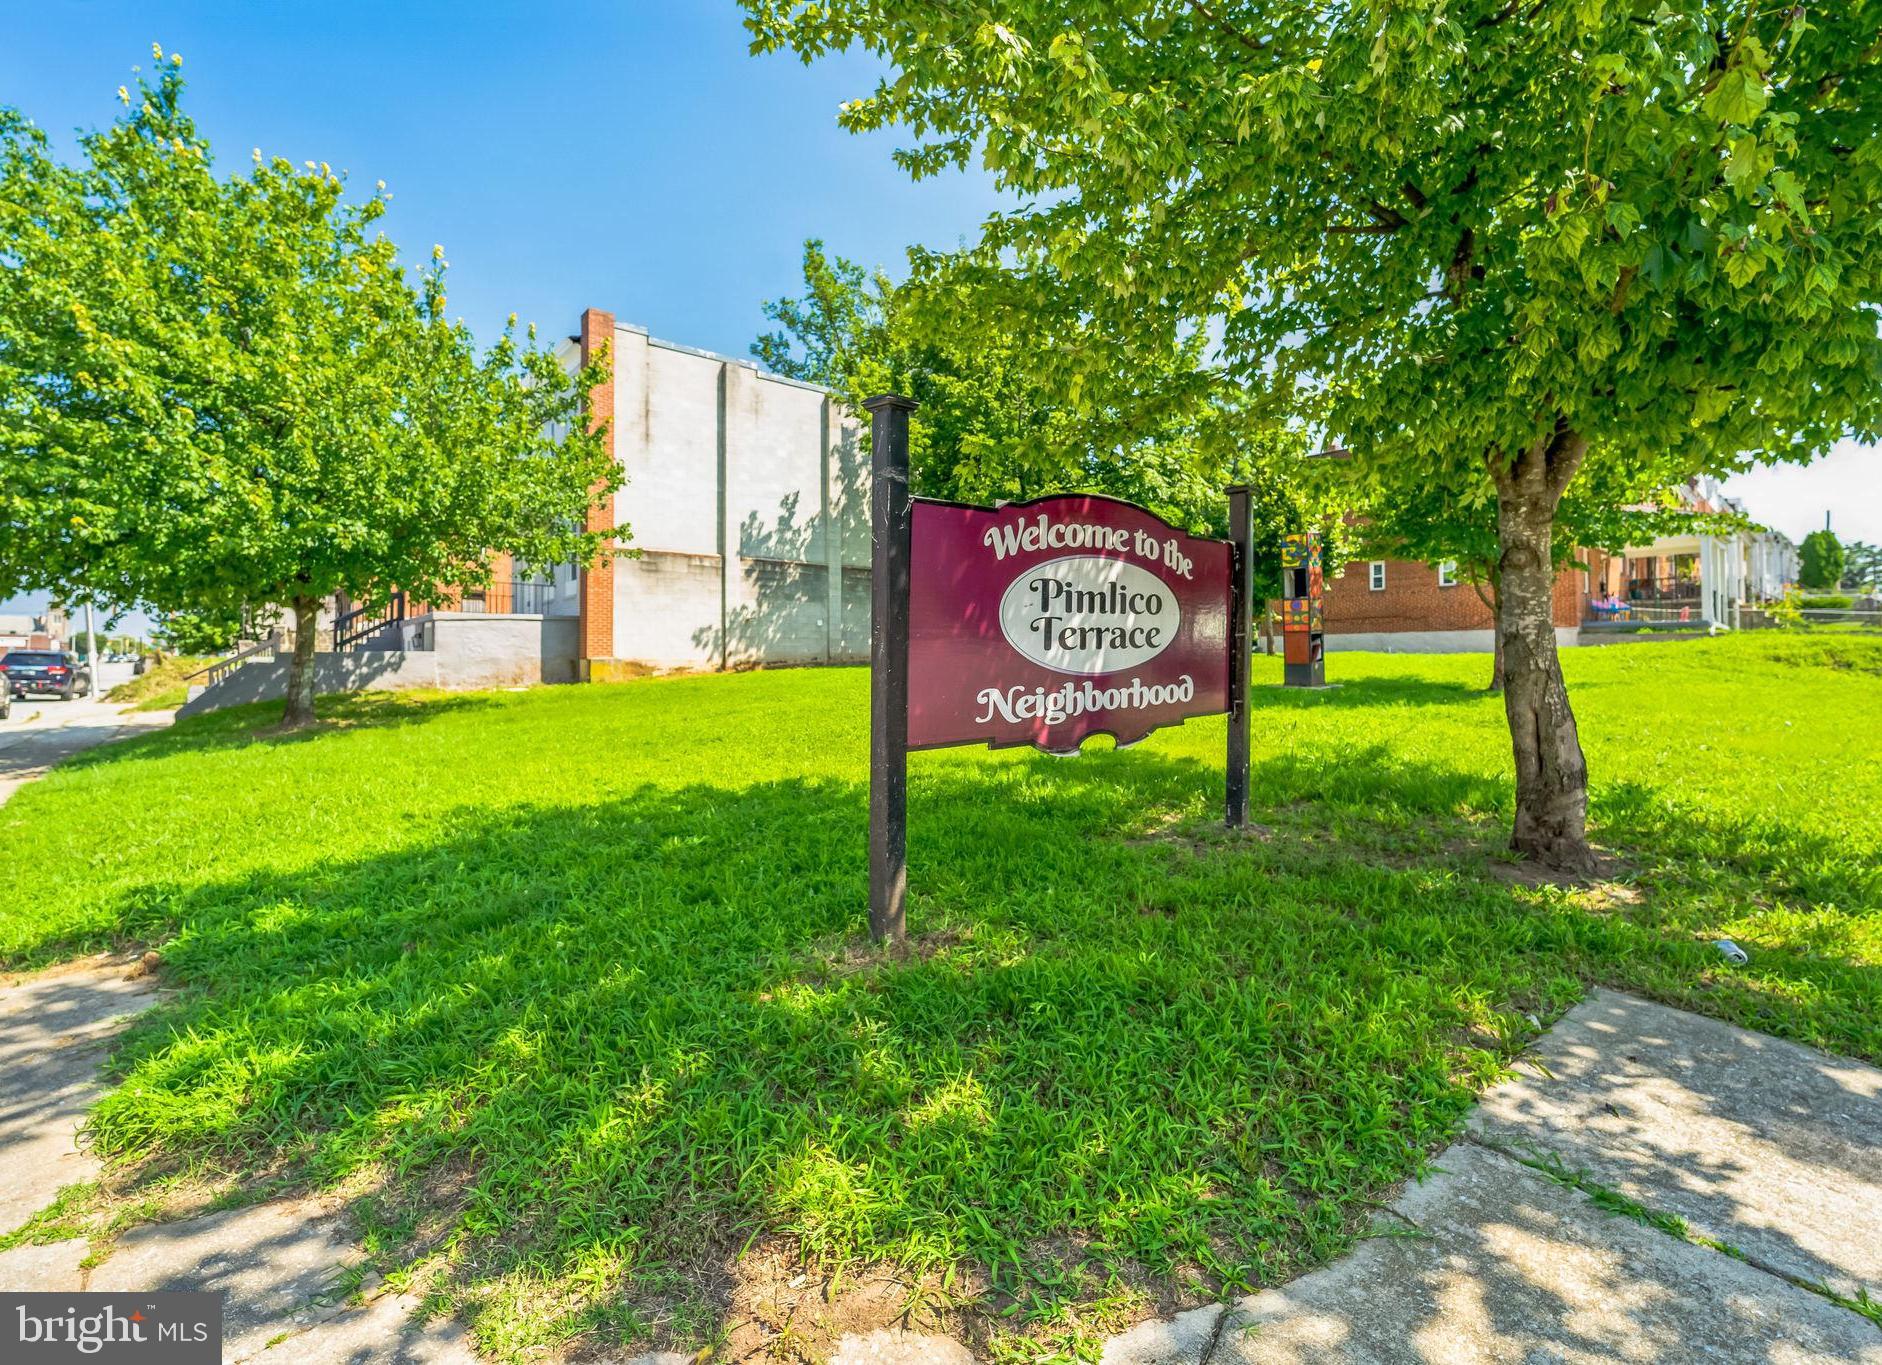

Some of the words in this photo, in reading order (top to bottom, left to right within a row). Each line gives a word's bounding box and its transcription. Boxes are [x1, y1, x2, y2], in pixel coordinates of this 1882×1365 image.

[984, 514, 1129, 560] Welcome
[1134, 529, 1160, 560] to
[1163, 539, 1194, 580] the
[1029, 578, 1163, 616] Pimlico
[1030, 617, 1161, 651] Terrace
[975, 674, 1194, 725] Neighborhood
